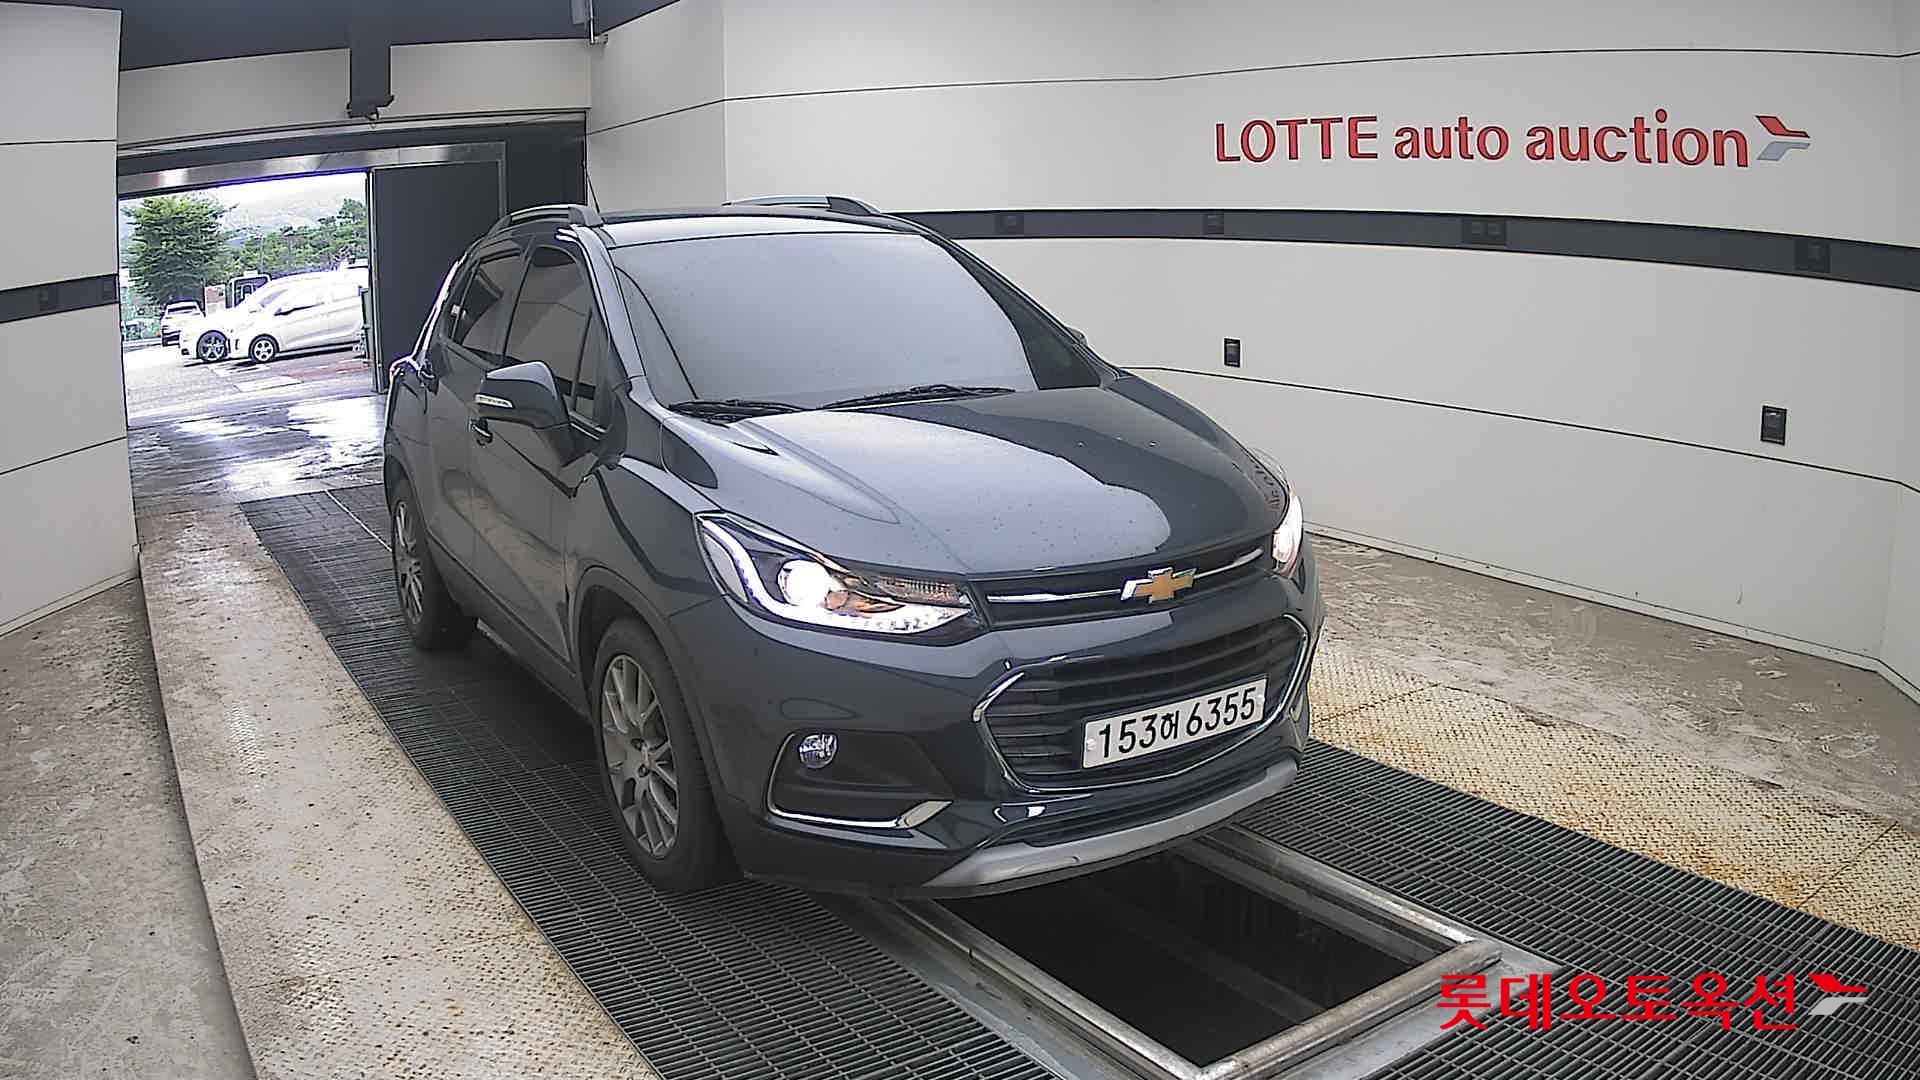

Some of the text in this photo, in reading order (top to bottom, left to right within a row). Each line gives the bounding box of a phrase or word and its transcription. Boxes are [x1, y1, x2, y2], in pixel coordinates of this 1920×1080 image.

[1215, 109, 1749, 168] LOTTE auto auction
[1099, 687, 1256, 758] 153허 6355
